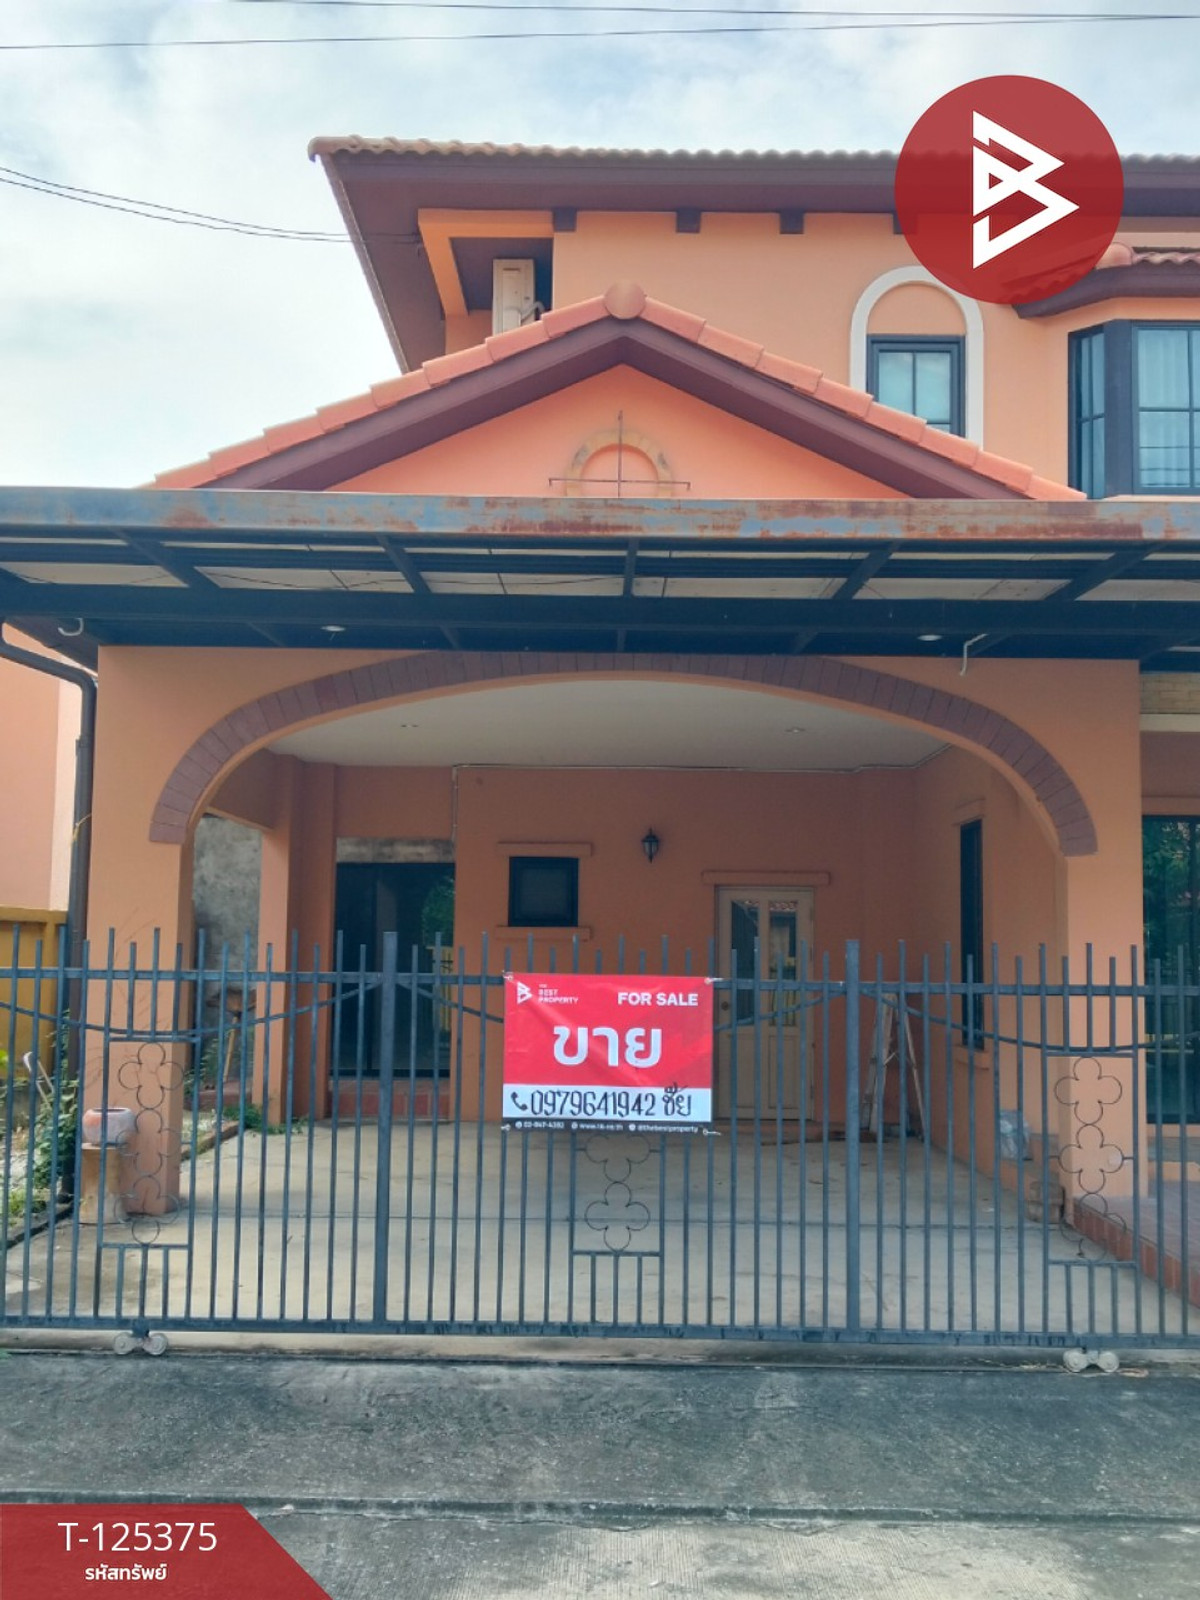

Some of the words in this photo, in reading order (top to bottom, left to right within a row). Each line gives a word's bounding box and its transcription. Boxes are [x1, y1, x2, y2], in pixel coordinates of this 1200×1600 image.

[538, 988, 559, 996] BEST
[618, 992, 651, 1006] FOR
[656, 992, 698, 1007] SALE
[538, 996, 579, 1004] PROPERTY
[553, 1025, 662, 1068] ขาย
[530, 1090, 656, 1118] 0979641942
